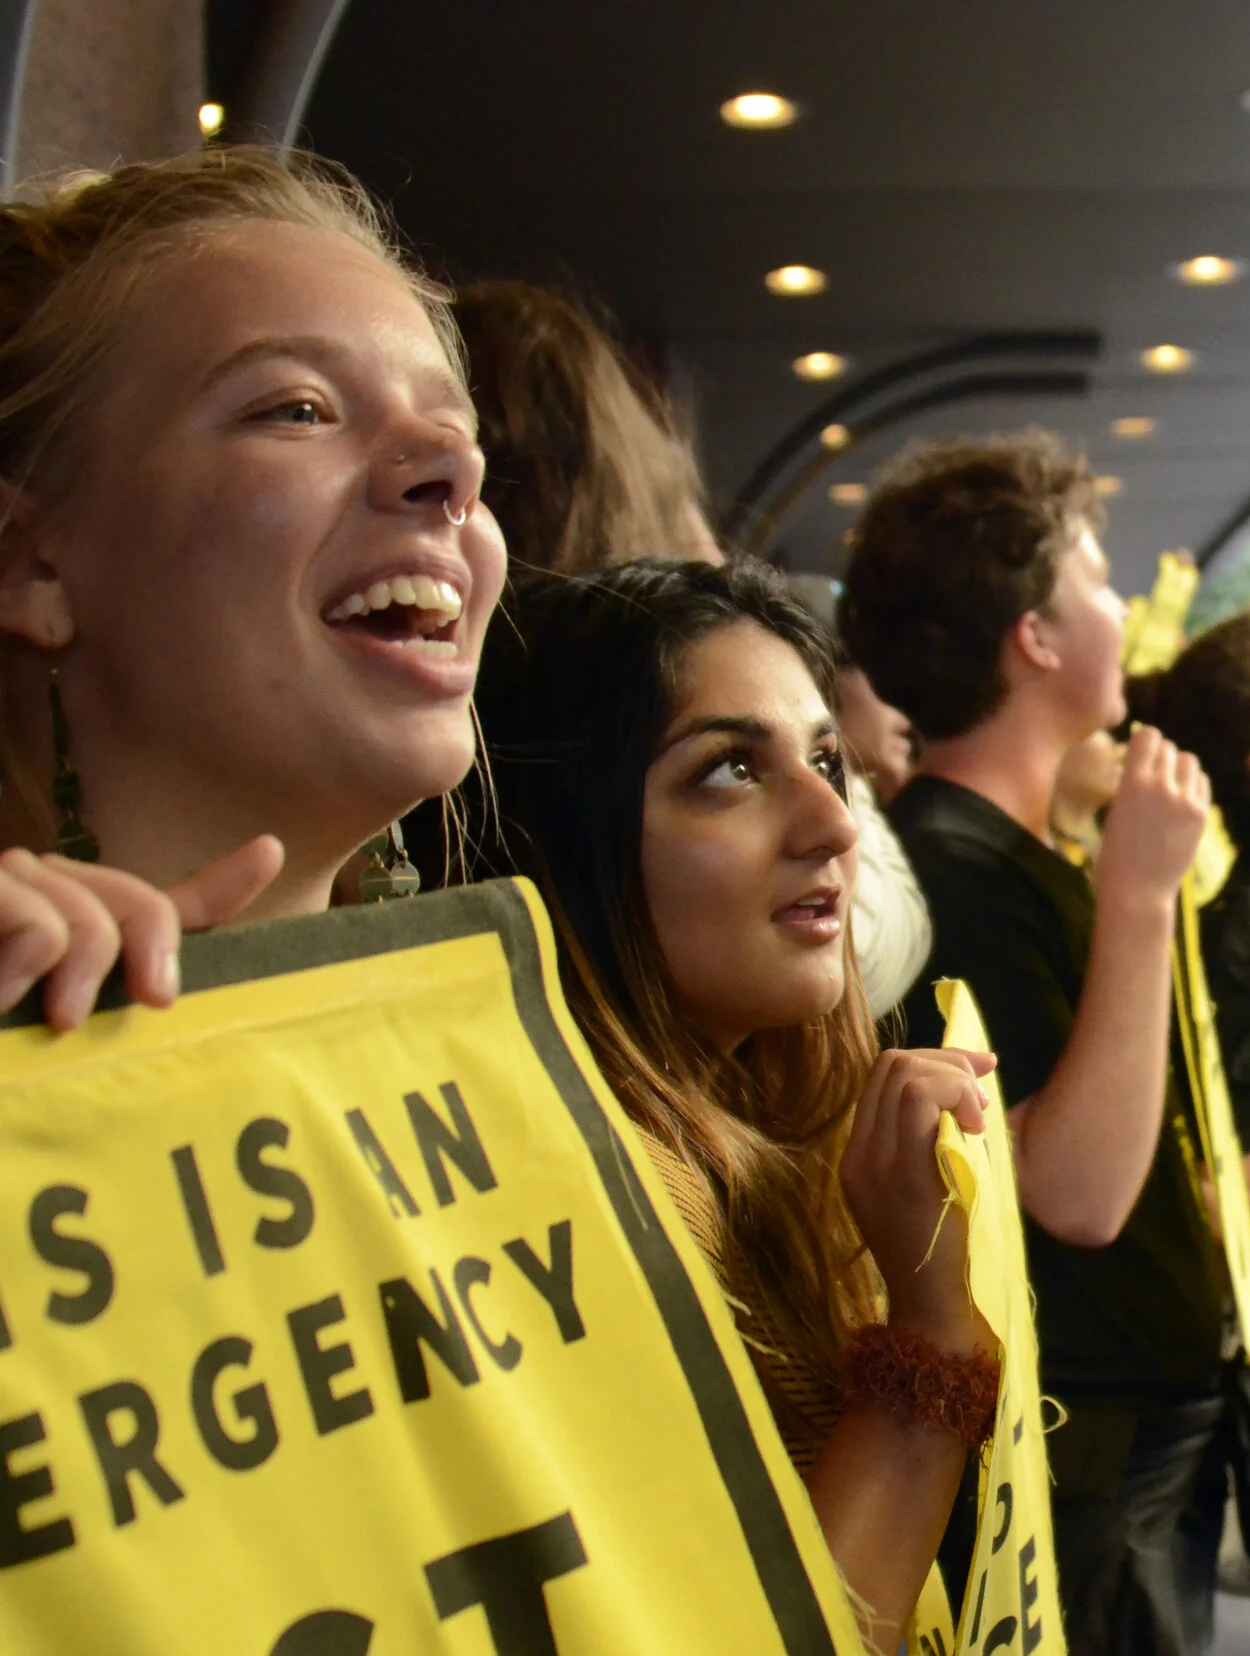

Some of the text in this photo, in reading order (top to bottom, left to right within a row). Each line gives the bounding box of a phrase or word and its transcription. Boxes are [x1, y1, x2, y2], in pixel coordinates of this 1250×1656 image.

[0, 1080, 498, 1349] S IS AN
